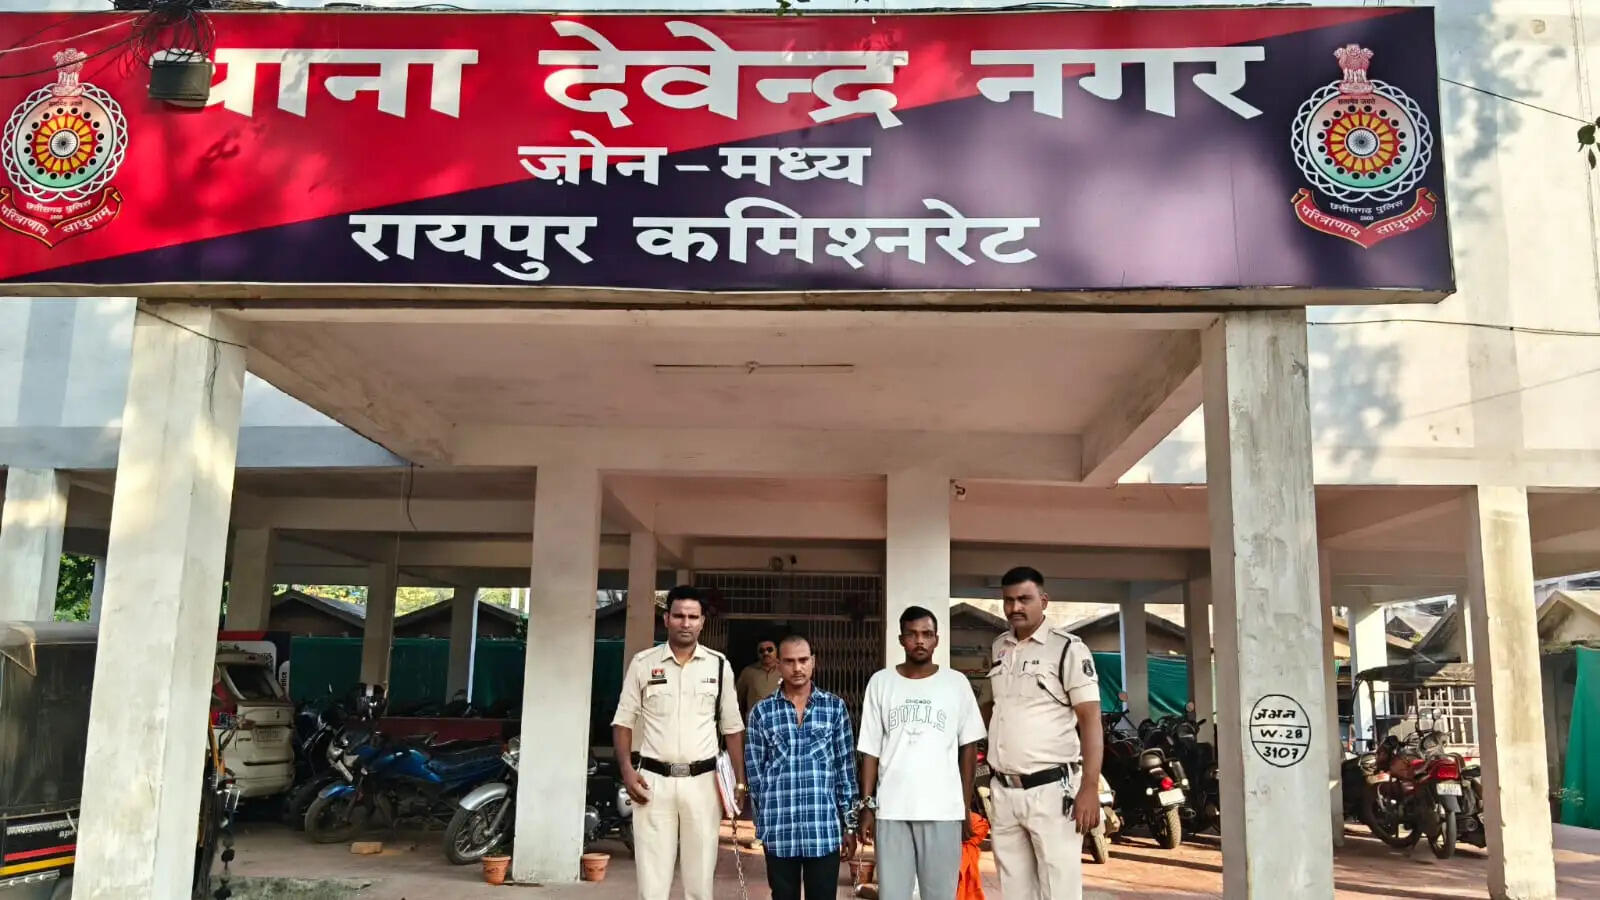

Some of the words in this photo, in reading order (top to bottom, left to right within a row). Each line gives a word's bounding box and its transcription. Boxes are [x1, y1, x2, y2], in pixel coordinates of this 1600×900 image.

[538, 20, 909, 130] देवेन्द्र
[970, 46, 1266, 120] नगर
[1301, 204, 1361, 238] परित्राणाय
[1376, 200, 1404, 214] पुलिस
[348, 214, 598, 281] रायपुर
[632, 196, 1041, 270] कमिश्नरेट
[888, 704, 947, 732] BULLS
[1263, 746, 1299, 759] 3107
